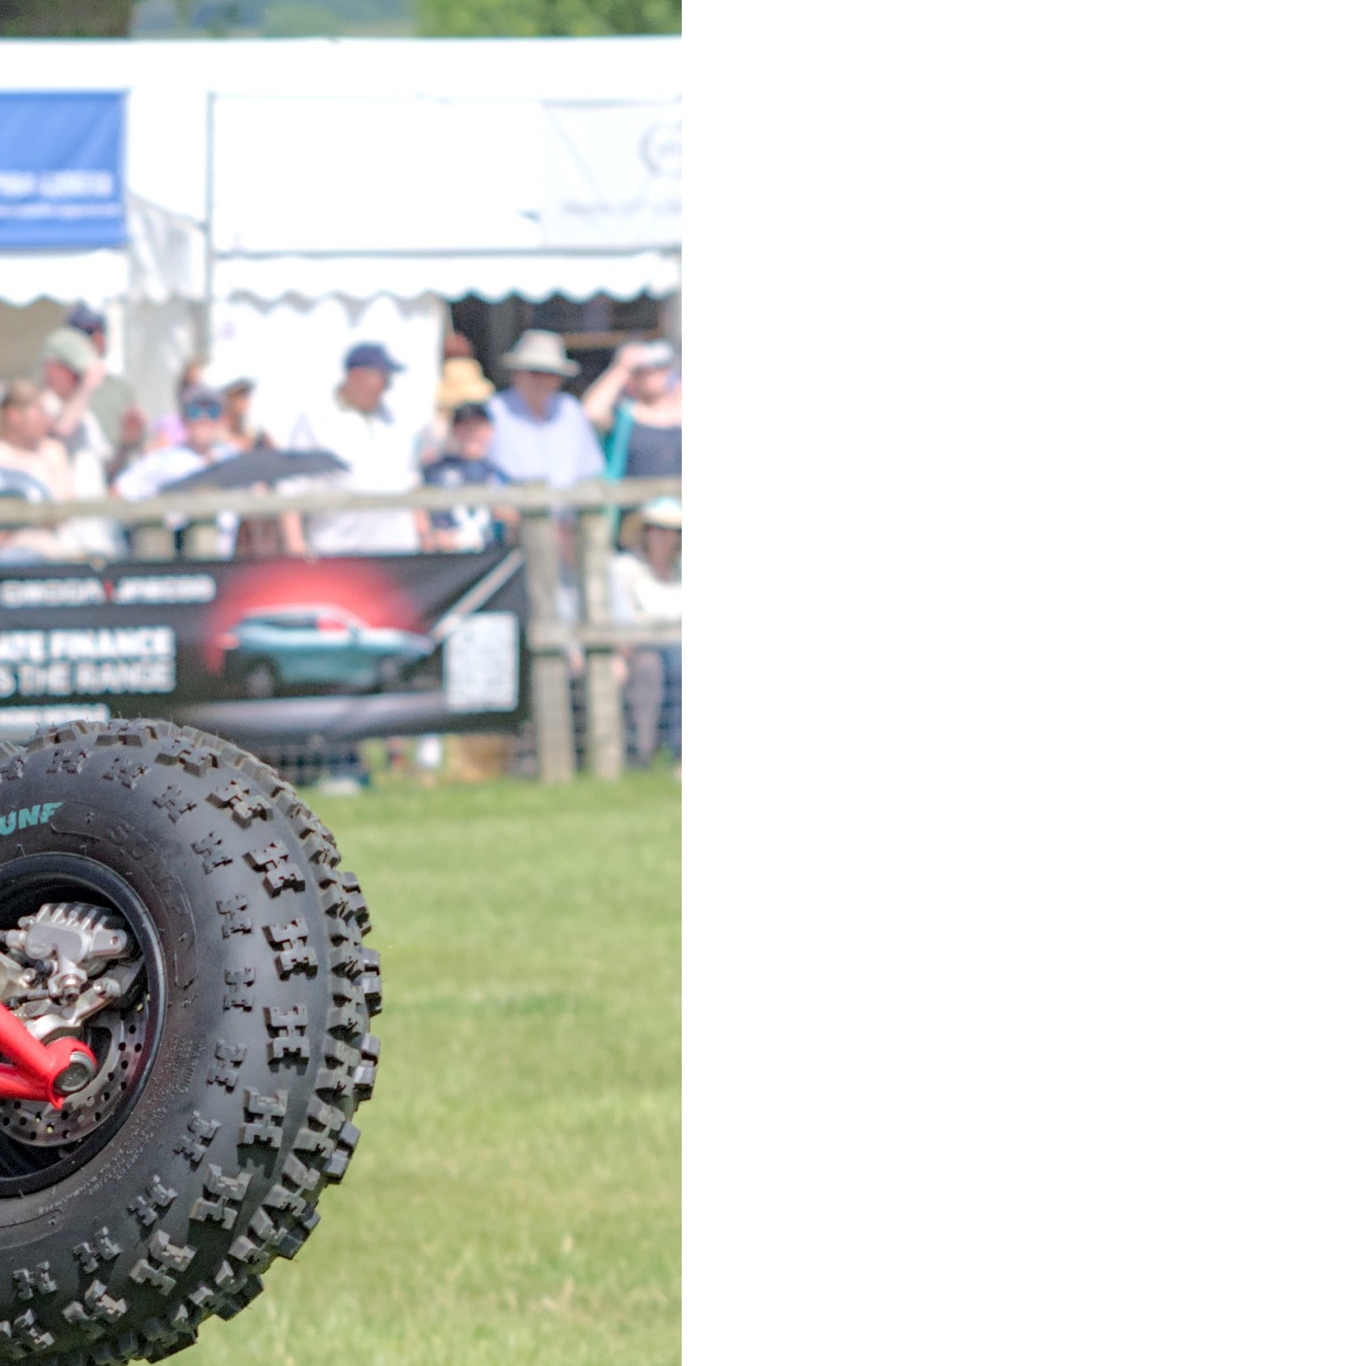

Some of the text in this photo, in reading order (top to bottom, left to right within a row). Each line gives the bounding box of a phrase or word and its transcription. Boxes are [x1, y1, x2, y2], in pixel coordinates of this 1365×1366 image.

[48, 627, 175, 659] FINANCE
[19, 663, 71, 695] THE
[76, 660, 176, 693] RANGE
